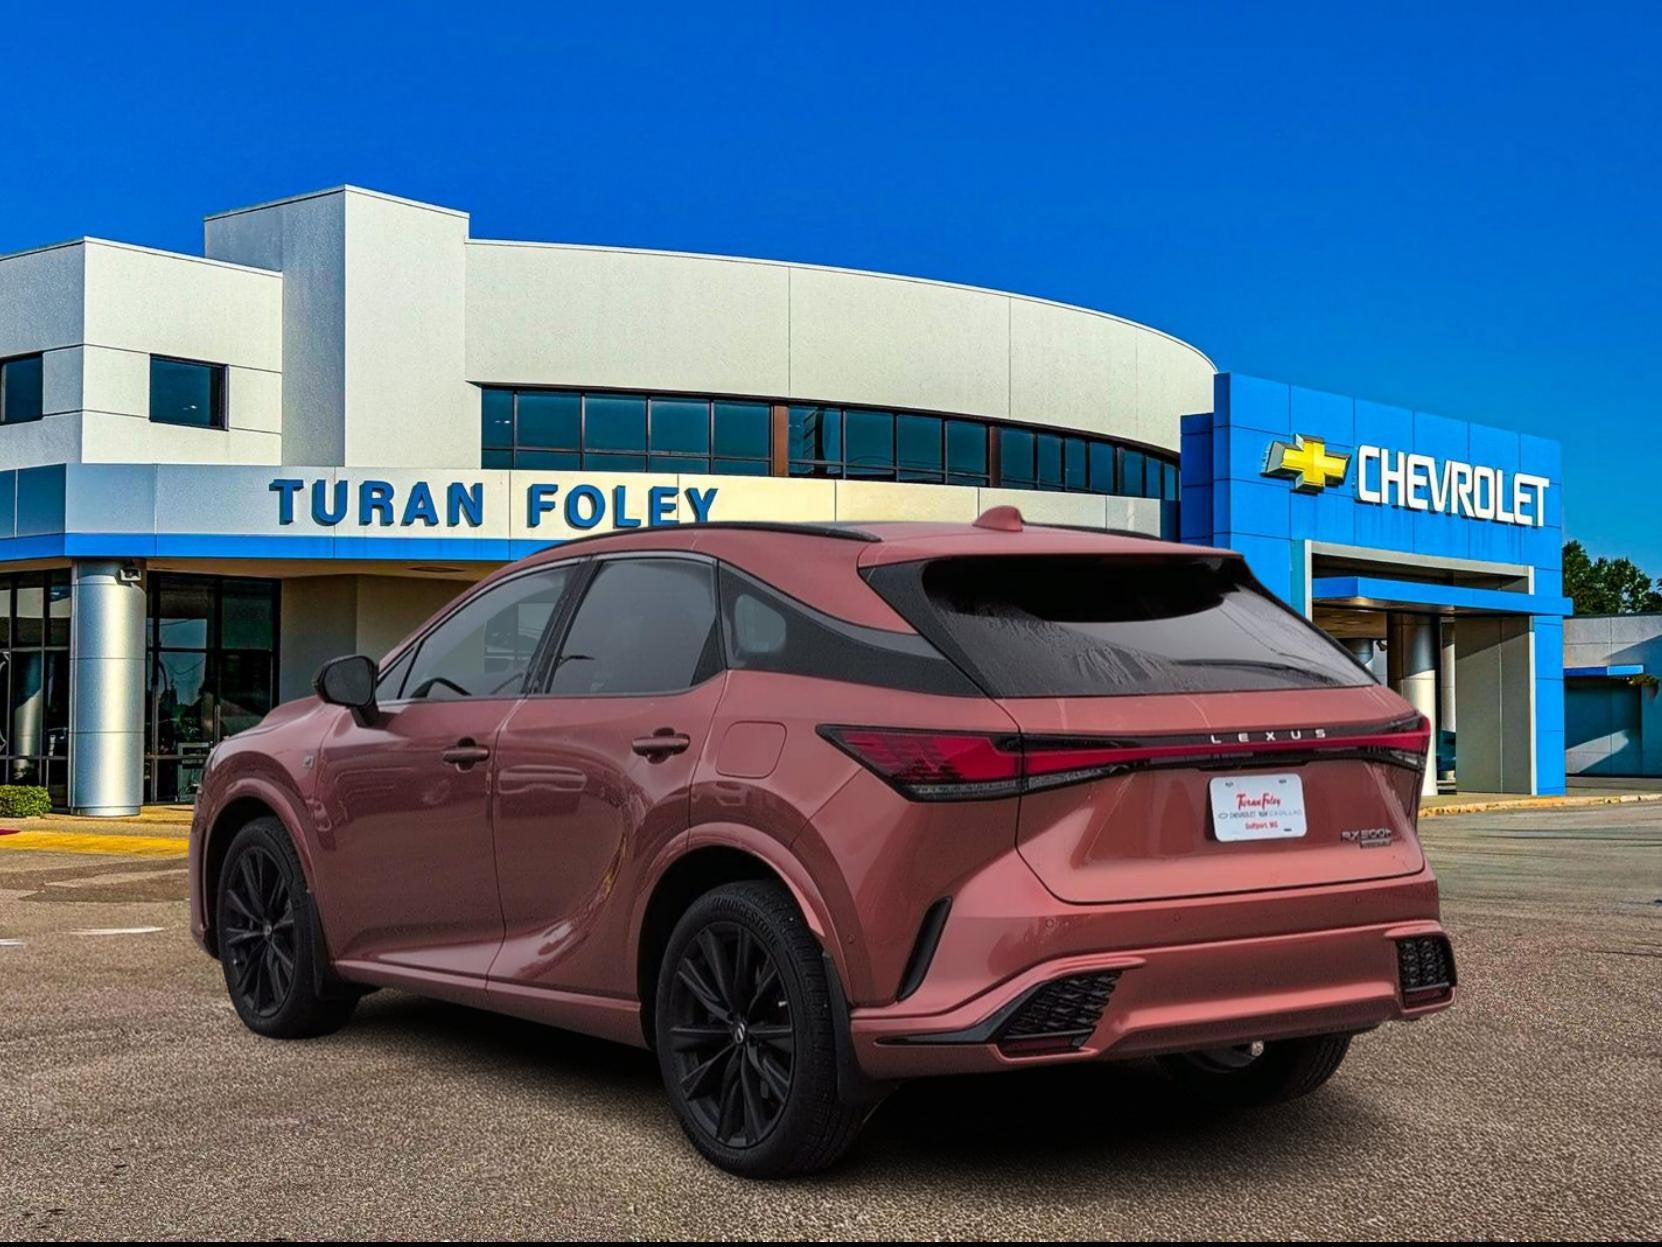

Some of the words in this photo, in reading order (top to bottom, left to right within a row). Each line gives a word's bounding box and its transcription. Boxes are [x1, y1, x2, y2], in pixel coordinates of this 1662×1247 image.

[269, 479, 484, 528] TURAN
[526, 483, 719, 530] FOLEY
[1357, 444, 1550, 528] CHEVROLET
[1210, 728, 1326, 744] LEXUS
